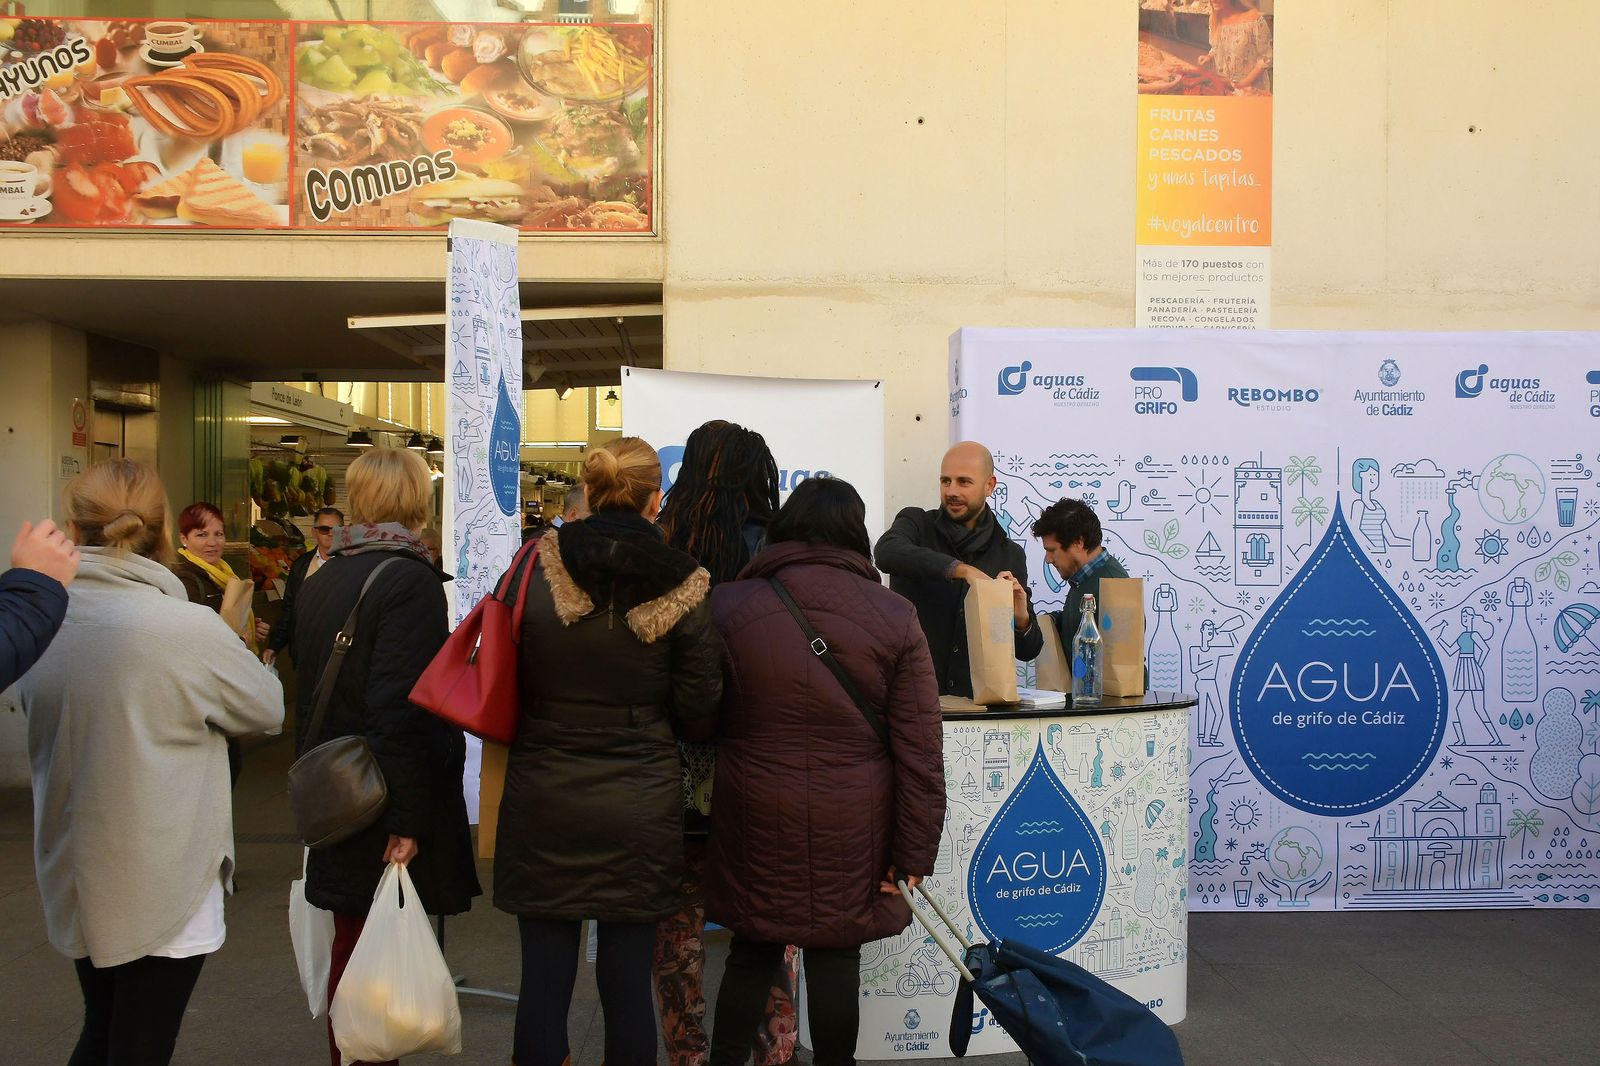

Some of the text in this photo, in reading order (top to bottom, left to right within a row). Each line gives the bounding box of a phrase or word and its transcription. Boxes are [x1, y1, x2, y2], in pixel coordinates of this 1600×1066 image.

[1149, 108, 1216, 122] FRUTAS
[1149, 128, 1219, 142] CARNES
[1149, 148, 1242, 162] PESCADOS
[305, 150, 456, 221] COMIDAS
[1147, 172, 1158, 191] y
[1162, 171, 1195, 185] unas
[1146, 213, 1260, 239] #voyalcentro
[1142, 258, 1163, 268] Más
[1165, 259, 1179, 268] de
[1181, 259, 1199, 268] 170
[1202, 260, 1243, 270] puestos
[1142, 272, 1264, 283] los mejores productos
[1213, 297, 1256, 305] FRUTERÍA
[1032, 375, 1085, 390] aguas
[1489, 378, 1541, 393] aguas
[1053, 387, 1100, 400] de Cádiz
[1134, 386, 1162, 400] PRO
[1228, 388, 1319, 405] REBOMBO
[1354, 388, 1426, 404] Ayuntamiento
[1509, 390, 1556, 403] de Cádiz
[1134, 401, 1178, 415] GRIFO
[1366, 404, 1413, 416] de Cádiz
[1257, 661, 1420, 703] AGUA
[1272, 711, 1405, 728] de grifo de Cádiz
[986, 848, 1091, 884] AGUA
[996, 883, 1081, 900] de grifo de Cádiz
[884, 1030, 940, 1043] Ayuntamiento
[893, 1041, 930, 1052] de Cádiz
